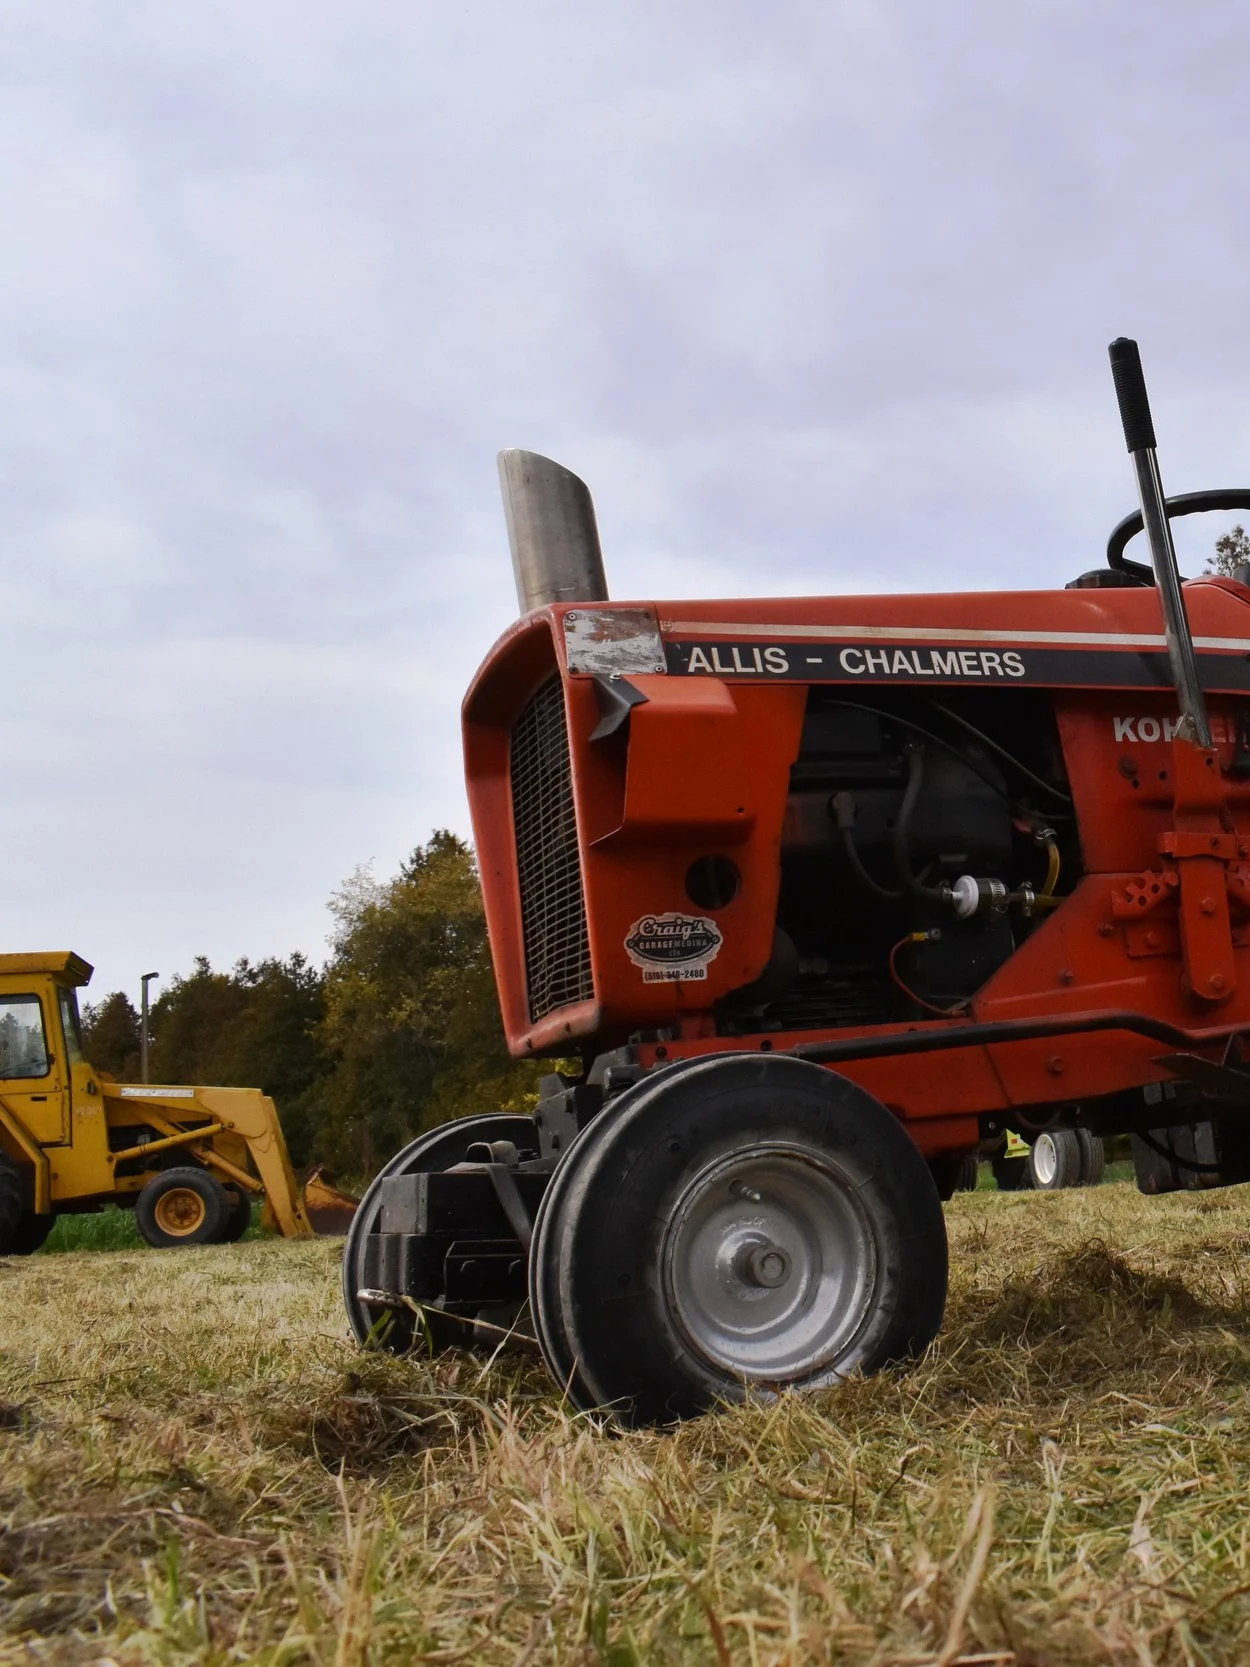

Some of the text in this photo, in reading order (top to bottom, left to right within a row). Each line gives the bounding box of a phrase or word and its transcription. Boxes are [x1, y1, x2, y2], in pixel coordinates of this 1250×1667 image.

[687, 646, 790, 674] ALLIS
[839, 647, 1026, 677] CHALMERS
[639, 918, 707, 940] Craig's
